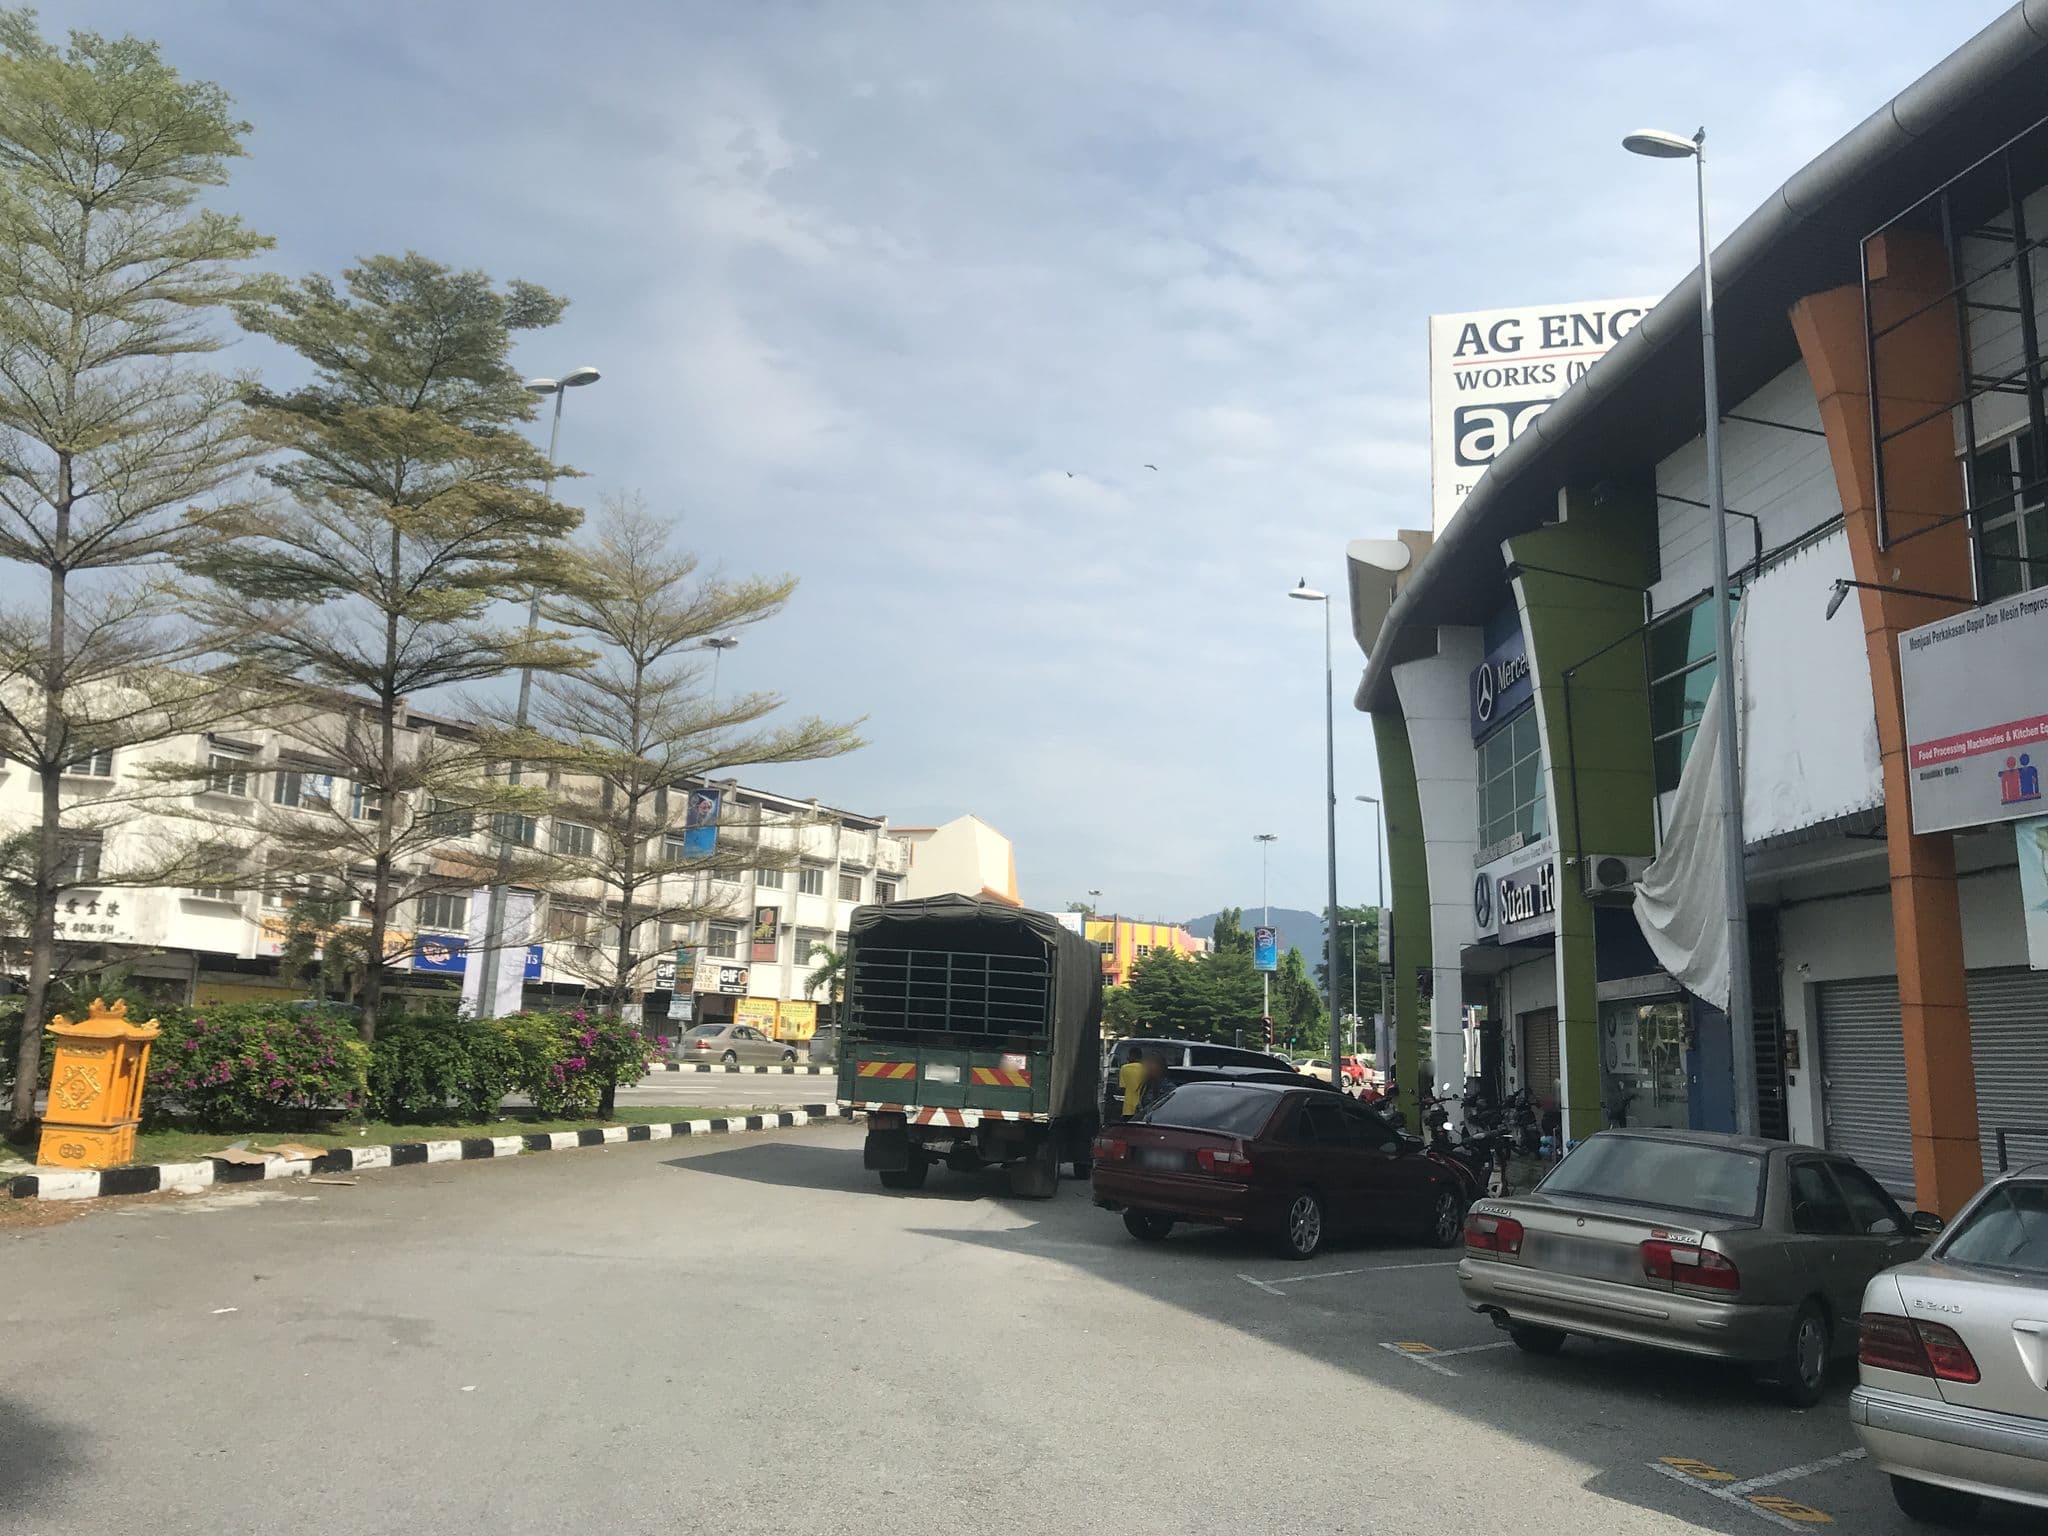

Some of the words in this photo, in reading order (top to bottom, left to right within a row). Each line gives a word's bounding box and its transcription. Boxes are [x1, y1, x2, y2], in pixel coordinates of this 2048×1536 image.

[1452, 318, 1524, 357] AG
[1539, 308, 1654, 349] ENG
[1453, 363, 1556, 391] WORKS
[1909, 632, 1932, 651] Menjual
[1932, 622, 1967, 645] Perkakasan
[1967, 617, 1985, 634] Dapur
[1986, 613, 1999, 627] Dan
[2000, 604, 2020, 623] Mesin
[1918, 748, 1933, 761] Food
[1933, 741, 1968, 758] Processing
[1967, 734, 2005, 750] Machineries
[2005, 730, 2012, 742] &
[2012, 726, 2040, 741] Kitchen
[1501, 879, 1535, 925] Suan
[657, 963, 676, 978] elf
[720, 968, 738, 983] elf
